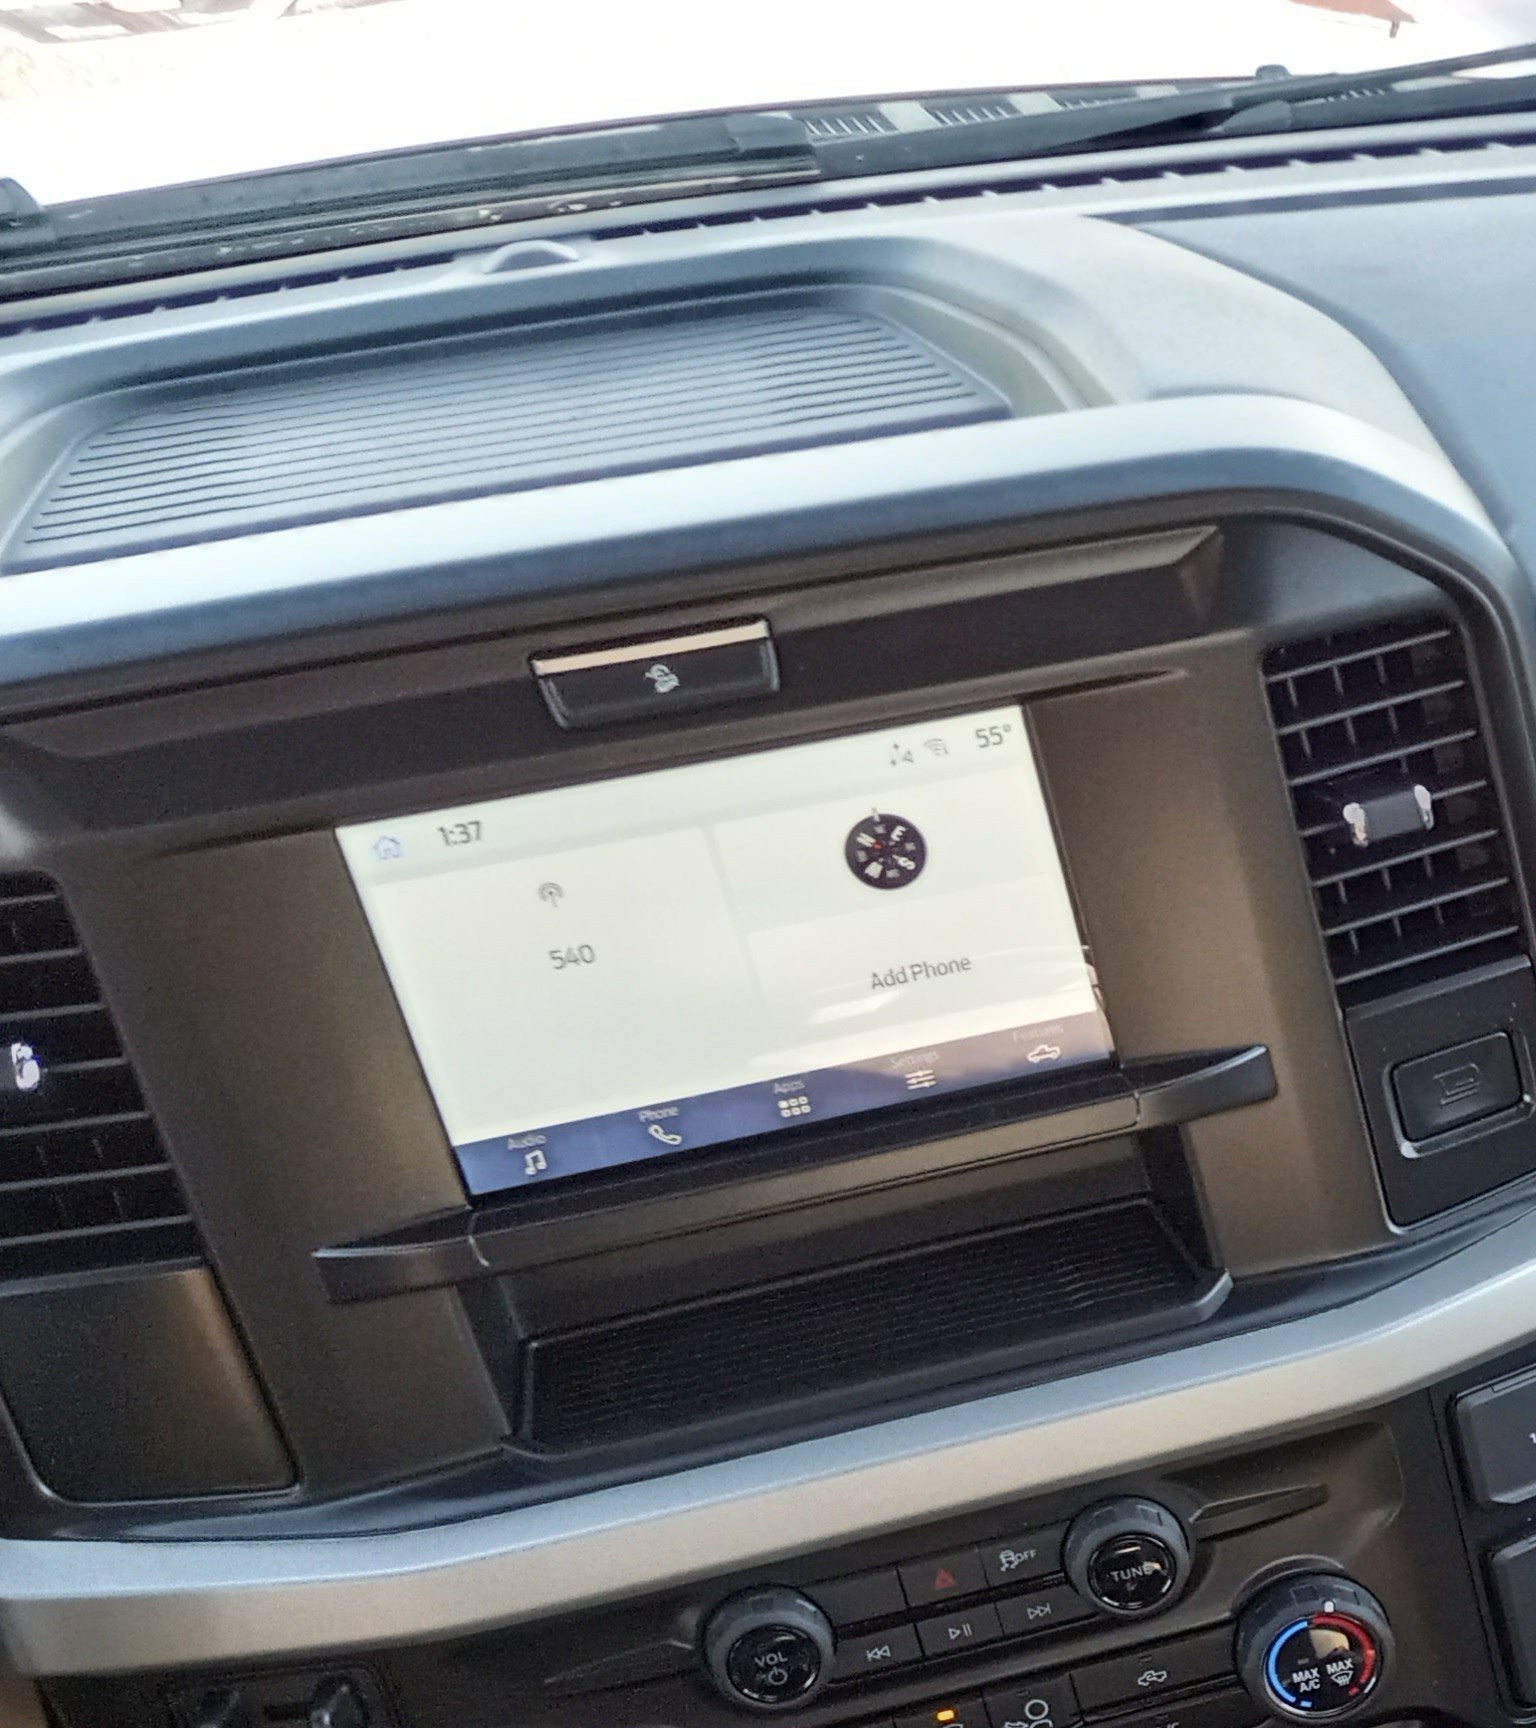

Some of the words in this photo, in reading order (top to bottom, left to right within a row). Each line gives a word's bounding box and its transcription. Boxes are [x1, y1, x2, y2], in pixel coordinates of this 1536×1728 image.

[436, 820, 483, 847] 1:37
[549, 944, 596, 970] 540
[871, 966, 908, 990] Add
[909, 957, 972, 982] Phone
[890, 1050, 941, 1070] Settings
[638, 1106, 680, 1123] Phone
[1016, 1549, 1037, 1563] OFF
[1111, 1564, 1154, 1582] TUNE
[754, 1651, 789, 1668] VOL
[1325, 1657, 1354, 1675] MAX
[1292, 1667, 1320, 1684] MAX
[1299, 1678, 1321, 1693] A/C
